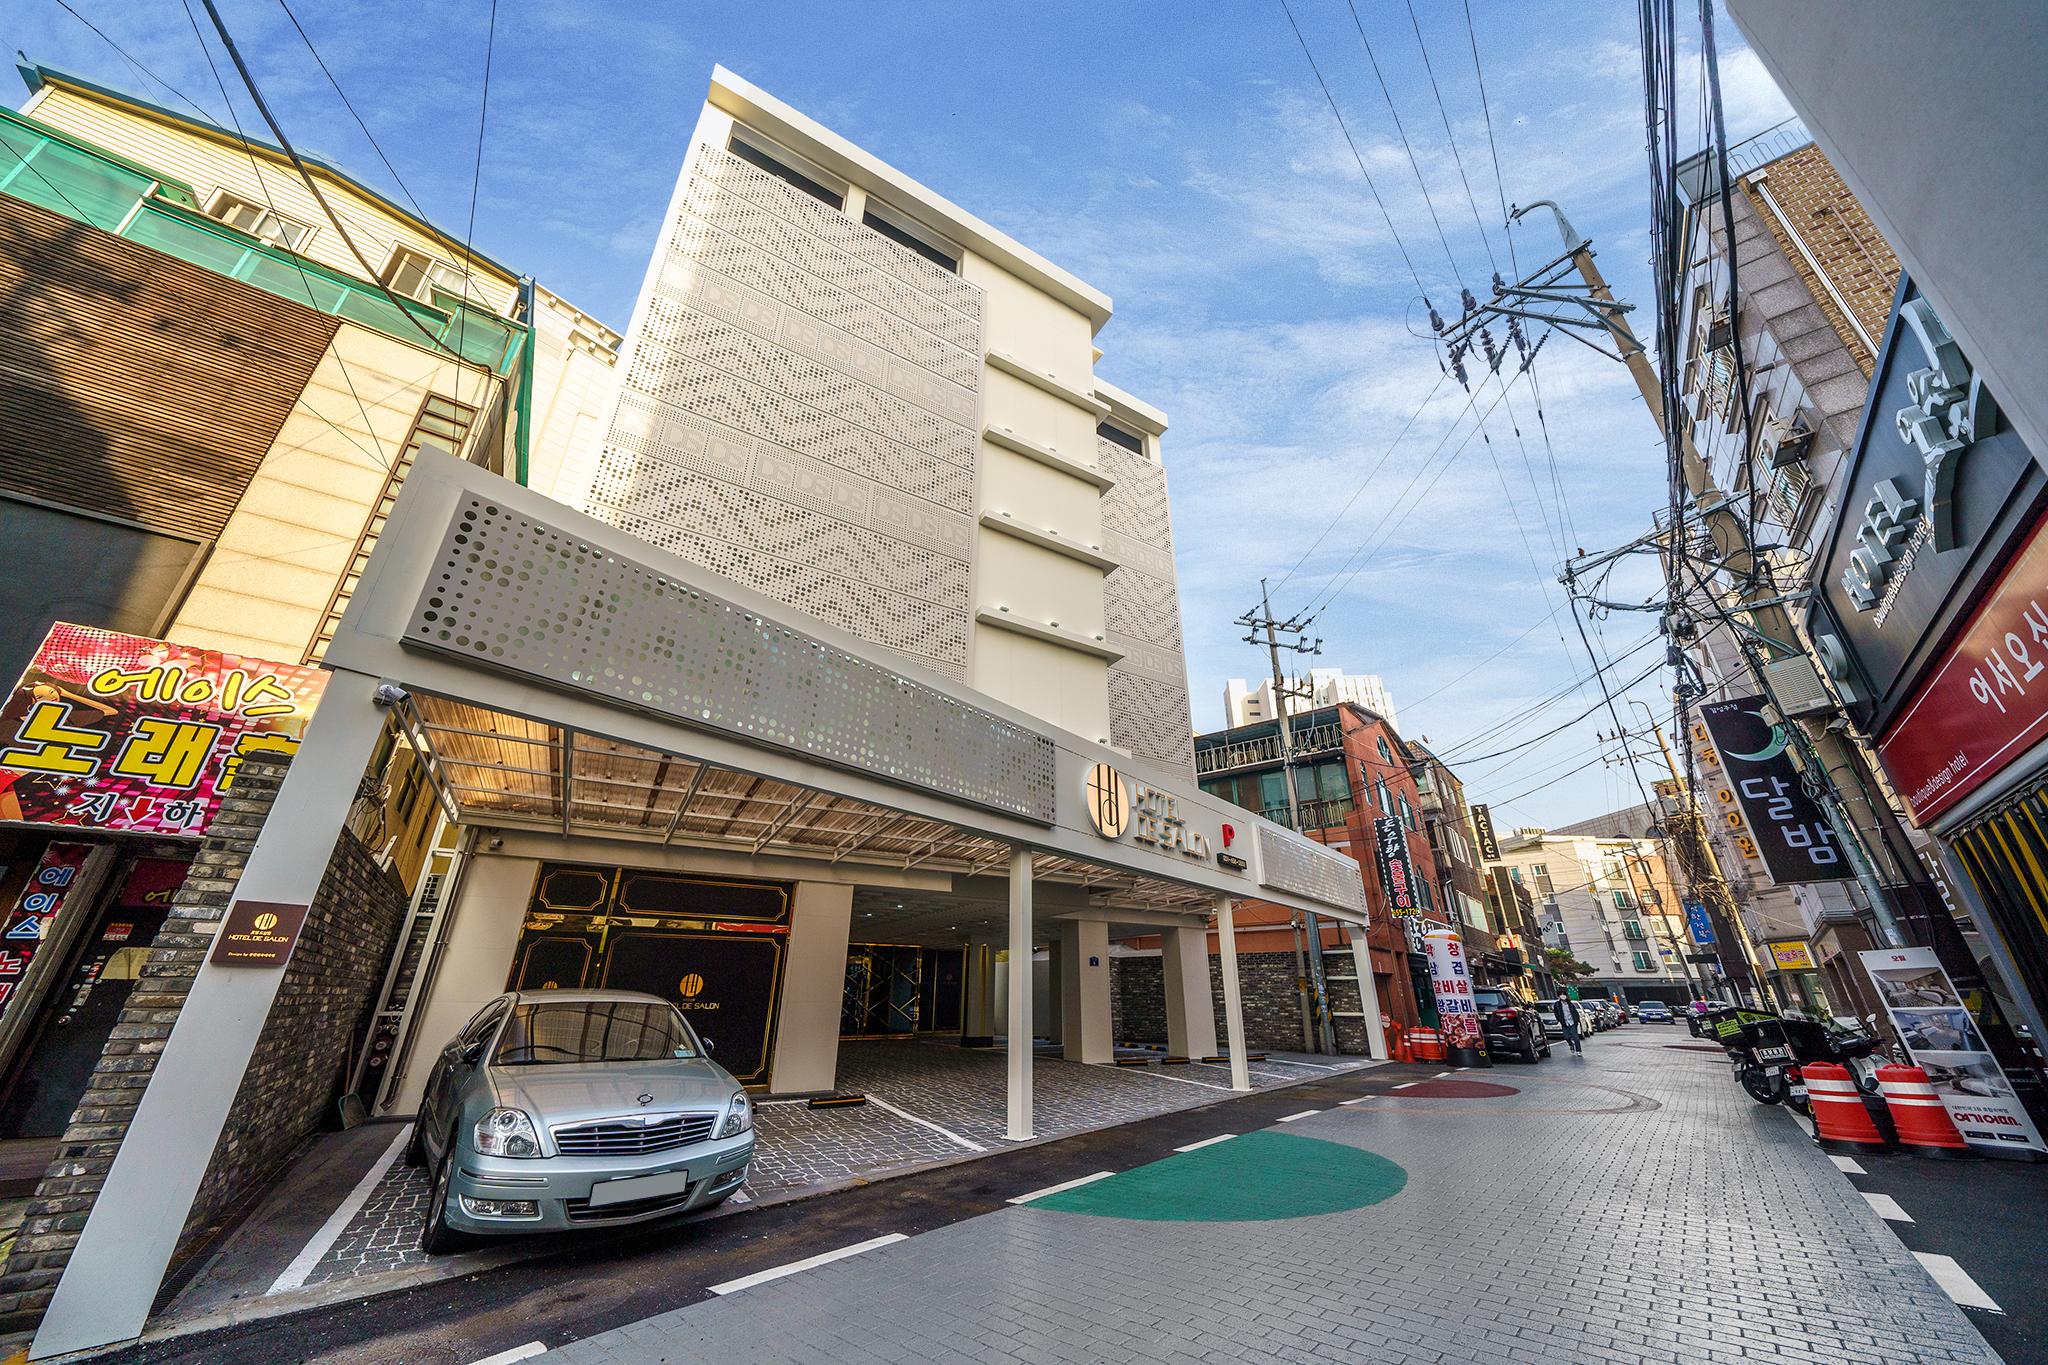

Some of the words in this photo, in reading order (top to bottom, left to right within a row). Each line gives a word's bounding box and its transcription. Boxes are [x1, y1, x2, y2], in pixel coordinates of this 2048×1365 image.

[1841, 480, 1917, 613] HOTEL
[91, 667, 295, 717] 에이스
[1950, 750, 1969, 780] hotel
[1131, 784, 1186, 826] HOTEL
[1740, 776, 1838, 865] 달밤
[1222, 824, 1235, 848] P
[6, 867, 75, 939] 에이스
[1434, 980, 1468, 994] 갈비살
